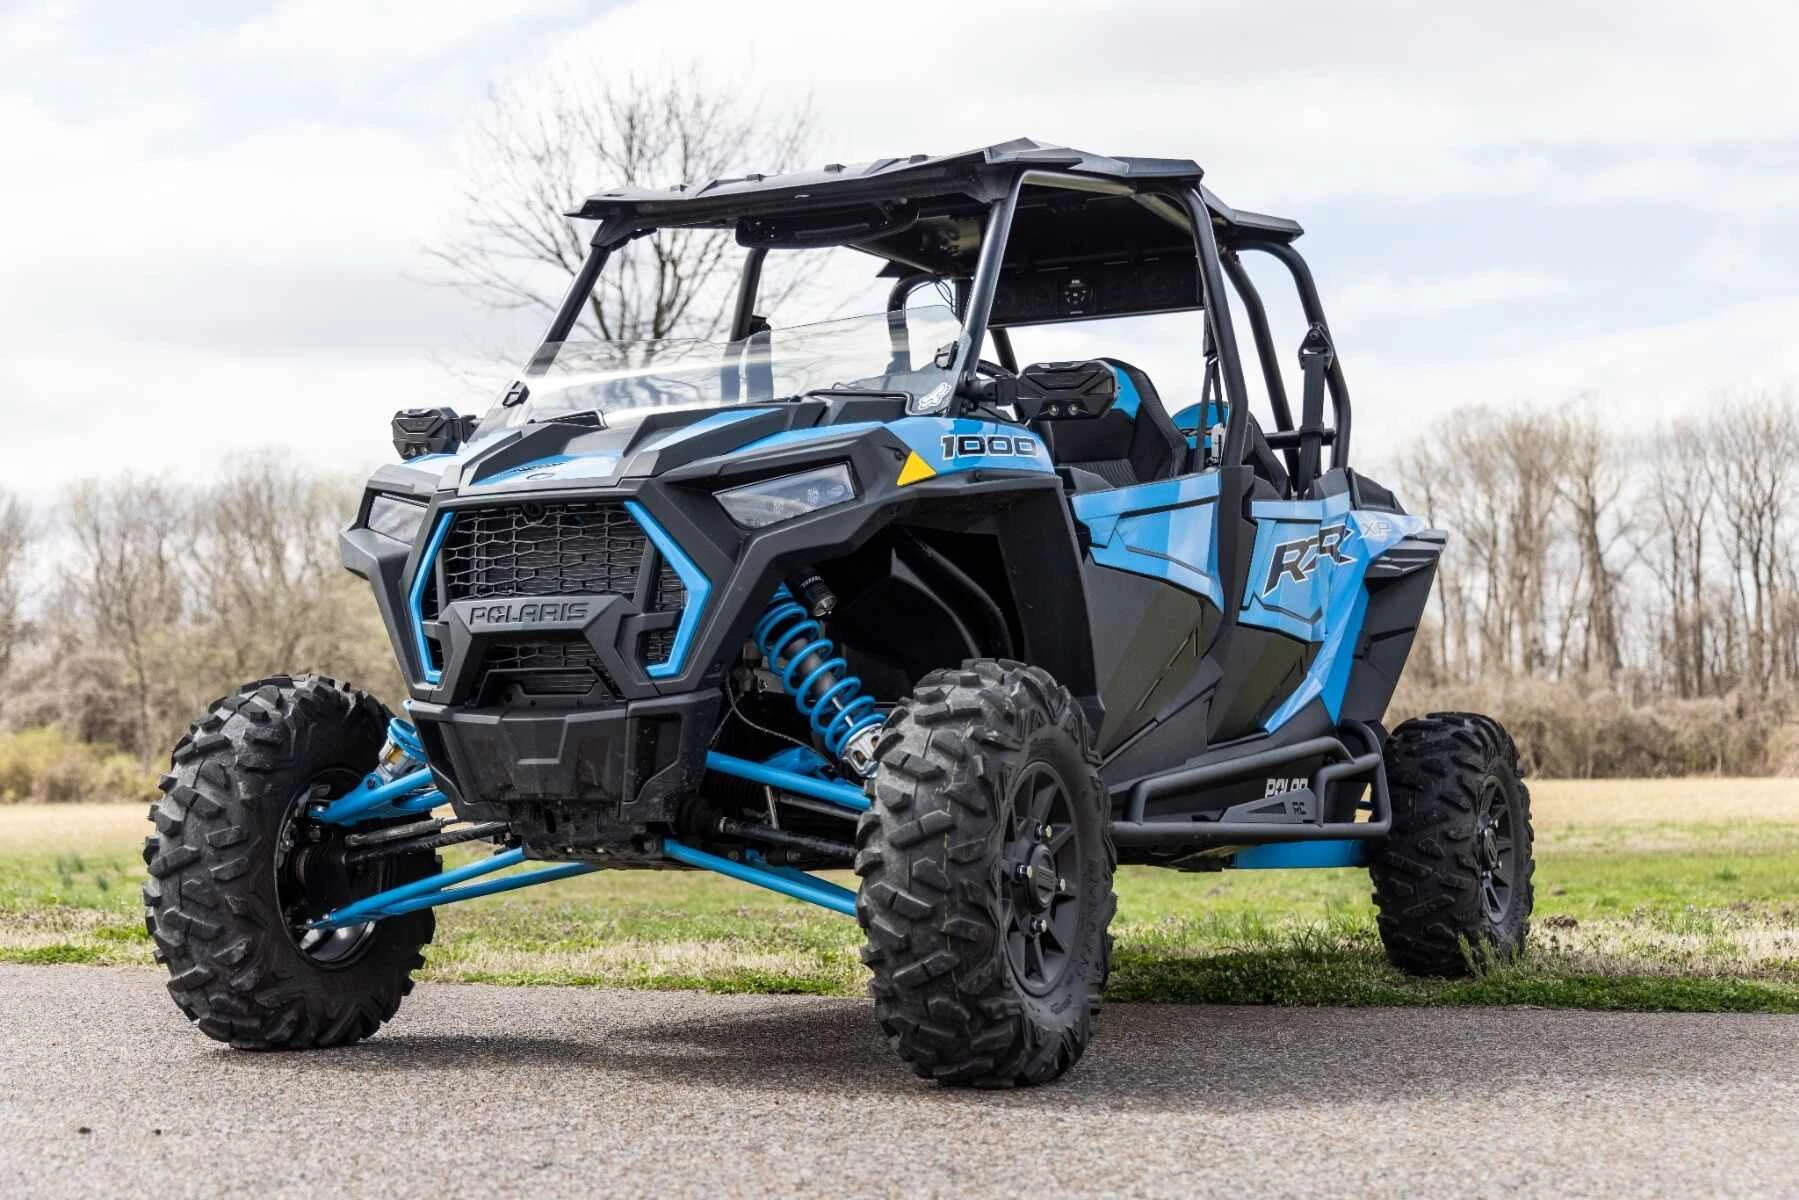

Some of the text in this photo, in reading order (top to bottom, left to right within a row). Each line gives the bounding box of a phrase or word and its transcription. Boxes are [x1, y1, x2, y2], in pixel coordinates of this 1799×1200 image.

[941, 434, 1040, 460] 1000
[1263, 523, 1358, 597] RZR
[469, 602, 588, 625] POLARIS
